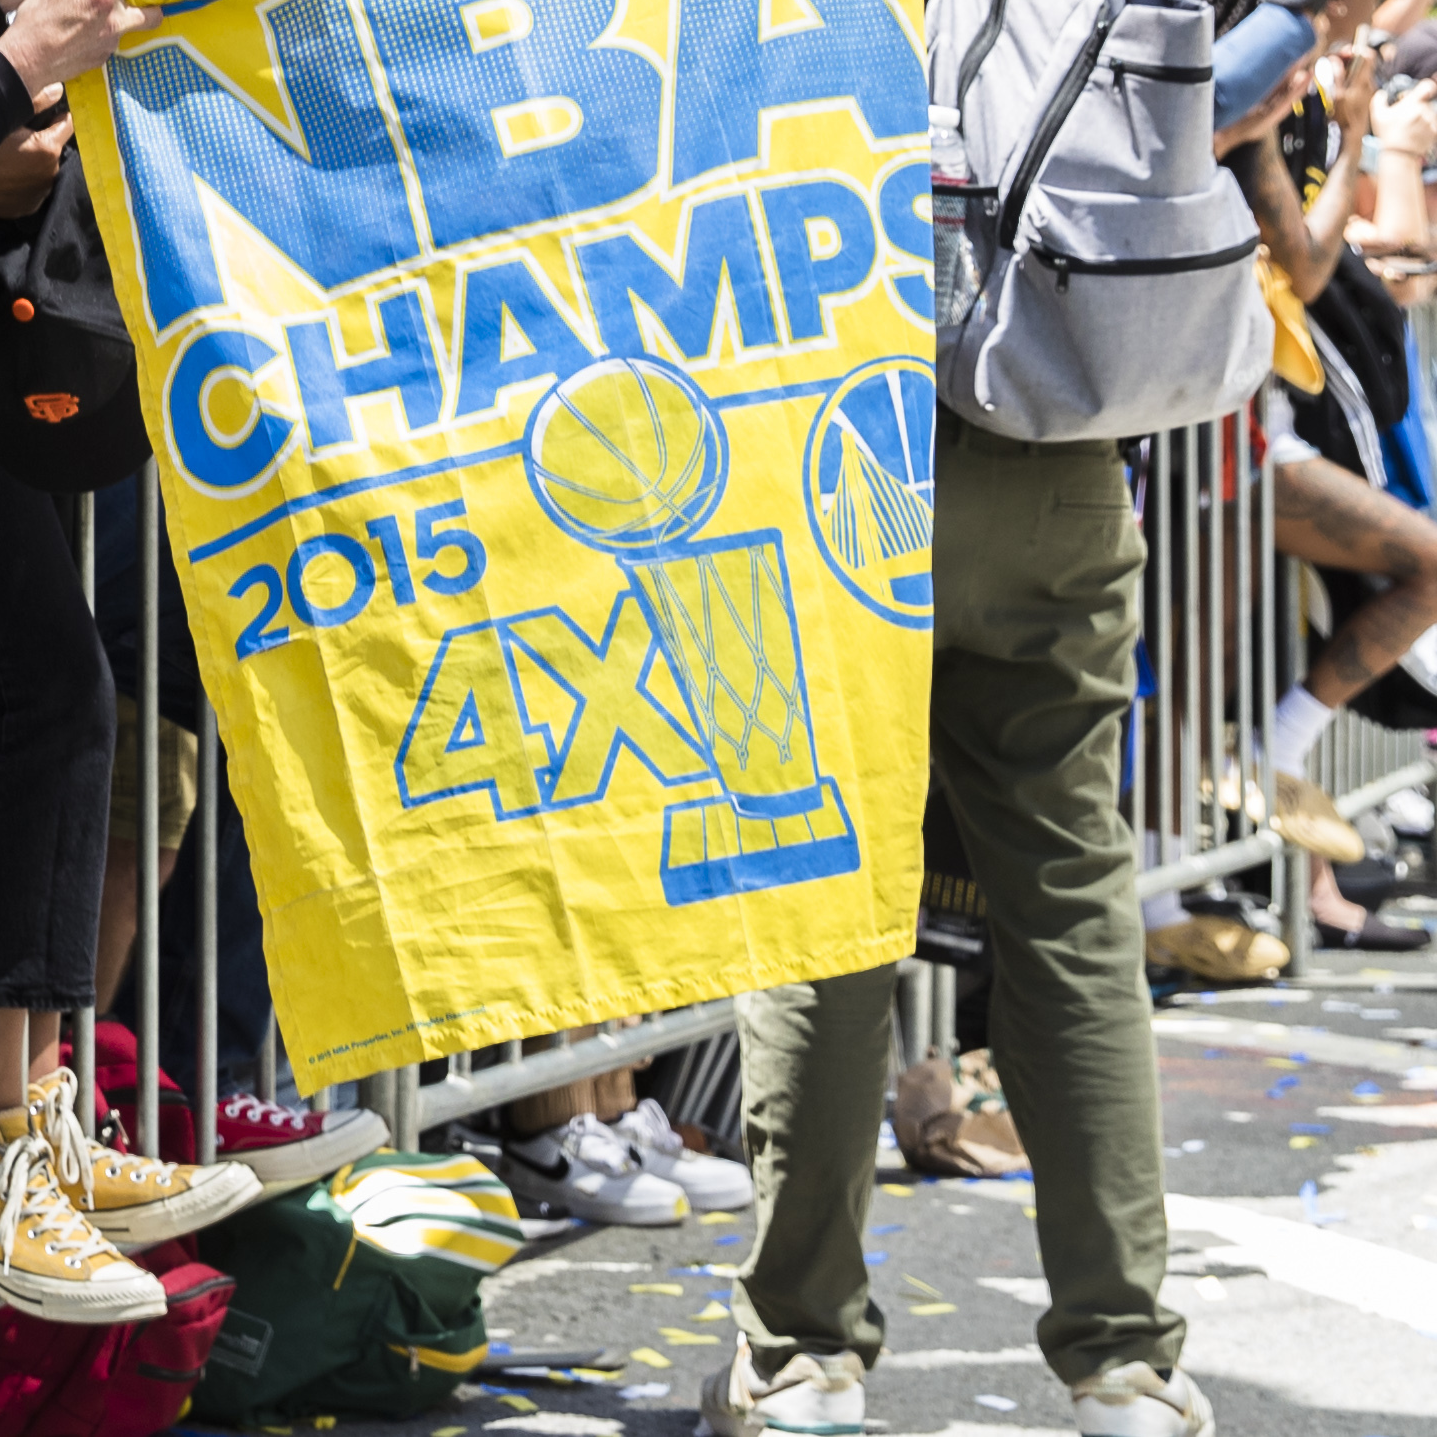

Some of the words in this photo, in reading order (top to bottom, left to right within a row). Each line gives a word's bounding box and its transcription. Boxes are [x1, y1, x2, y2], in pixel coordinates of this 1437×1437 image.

[165, 160, 936, 498] CHAMPS
[227, 498, 487, 661] 2015
[332, 1044, 351, 1056] NBA
